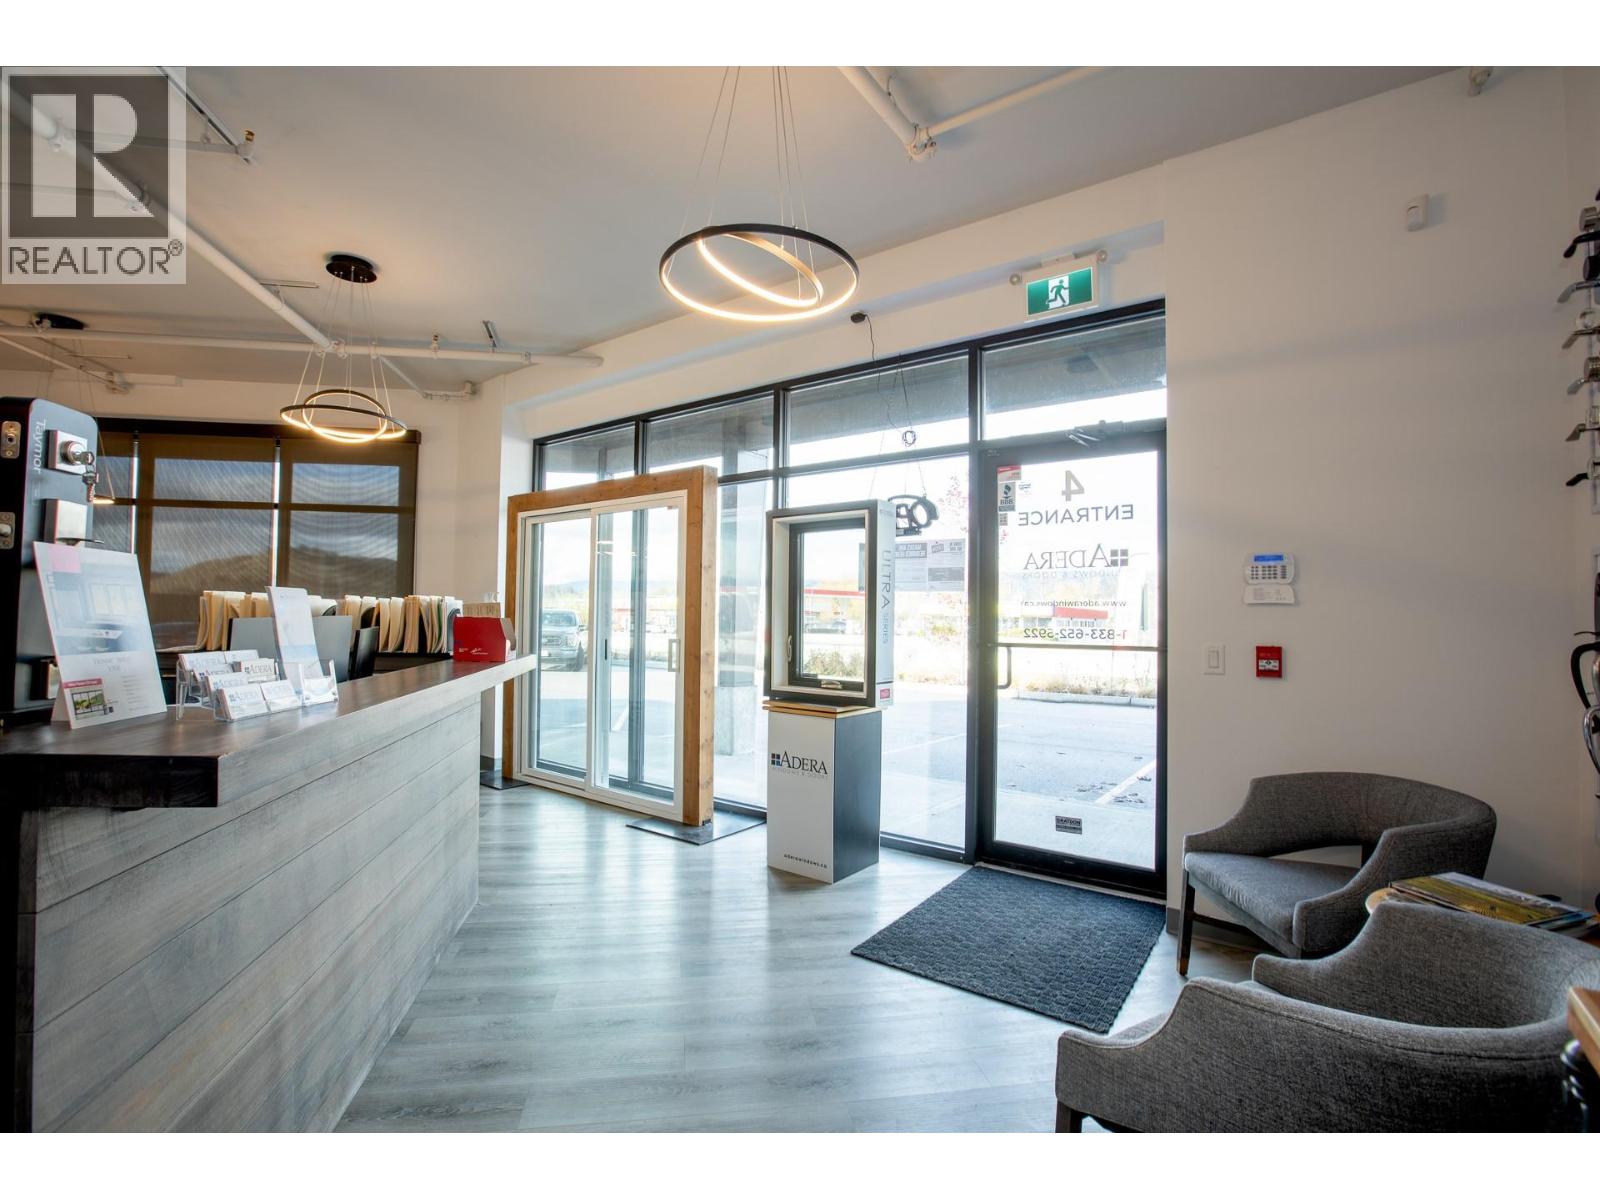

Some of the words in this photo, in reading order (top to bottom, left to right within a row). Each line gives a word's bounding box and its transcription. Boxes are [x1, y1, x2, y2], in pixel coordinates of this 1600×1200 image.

[32, 419, 47, 474] Taymor
[881, 550, 891, 609] ULTRA
[780, 750, 828, 774] ADERA
